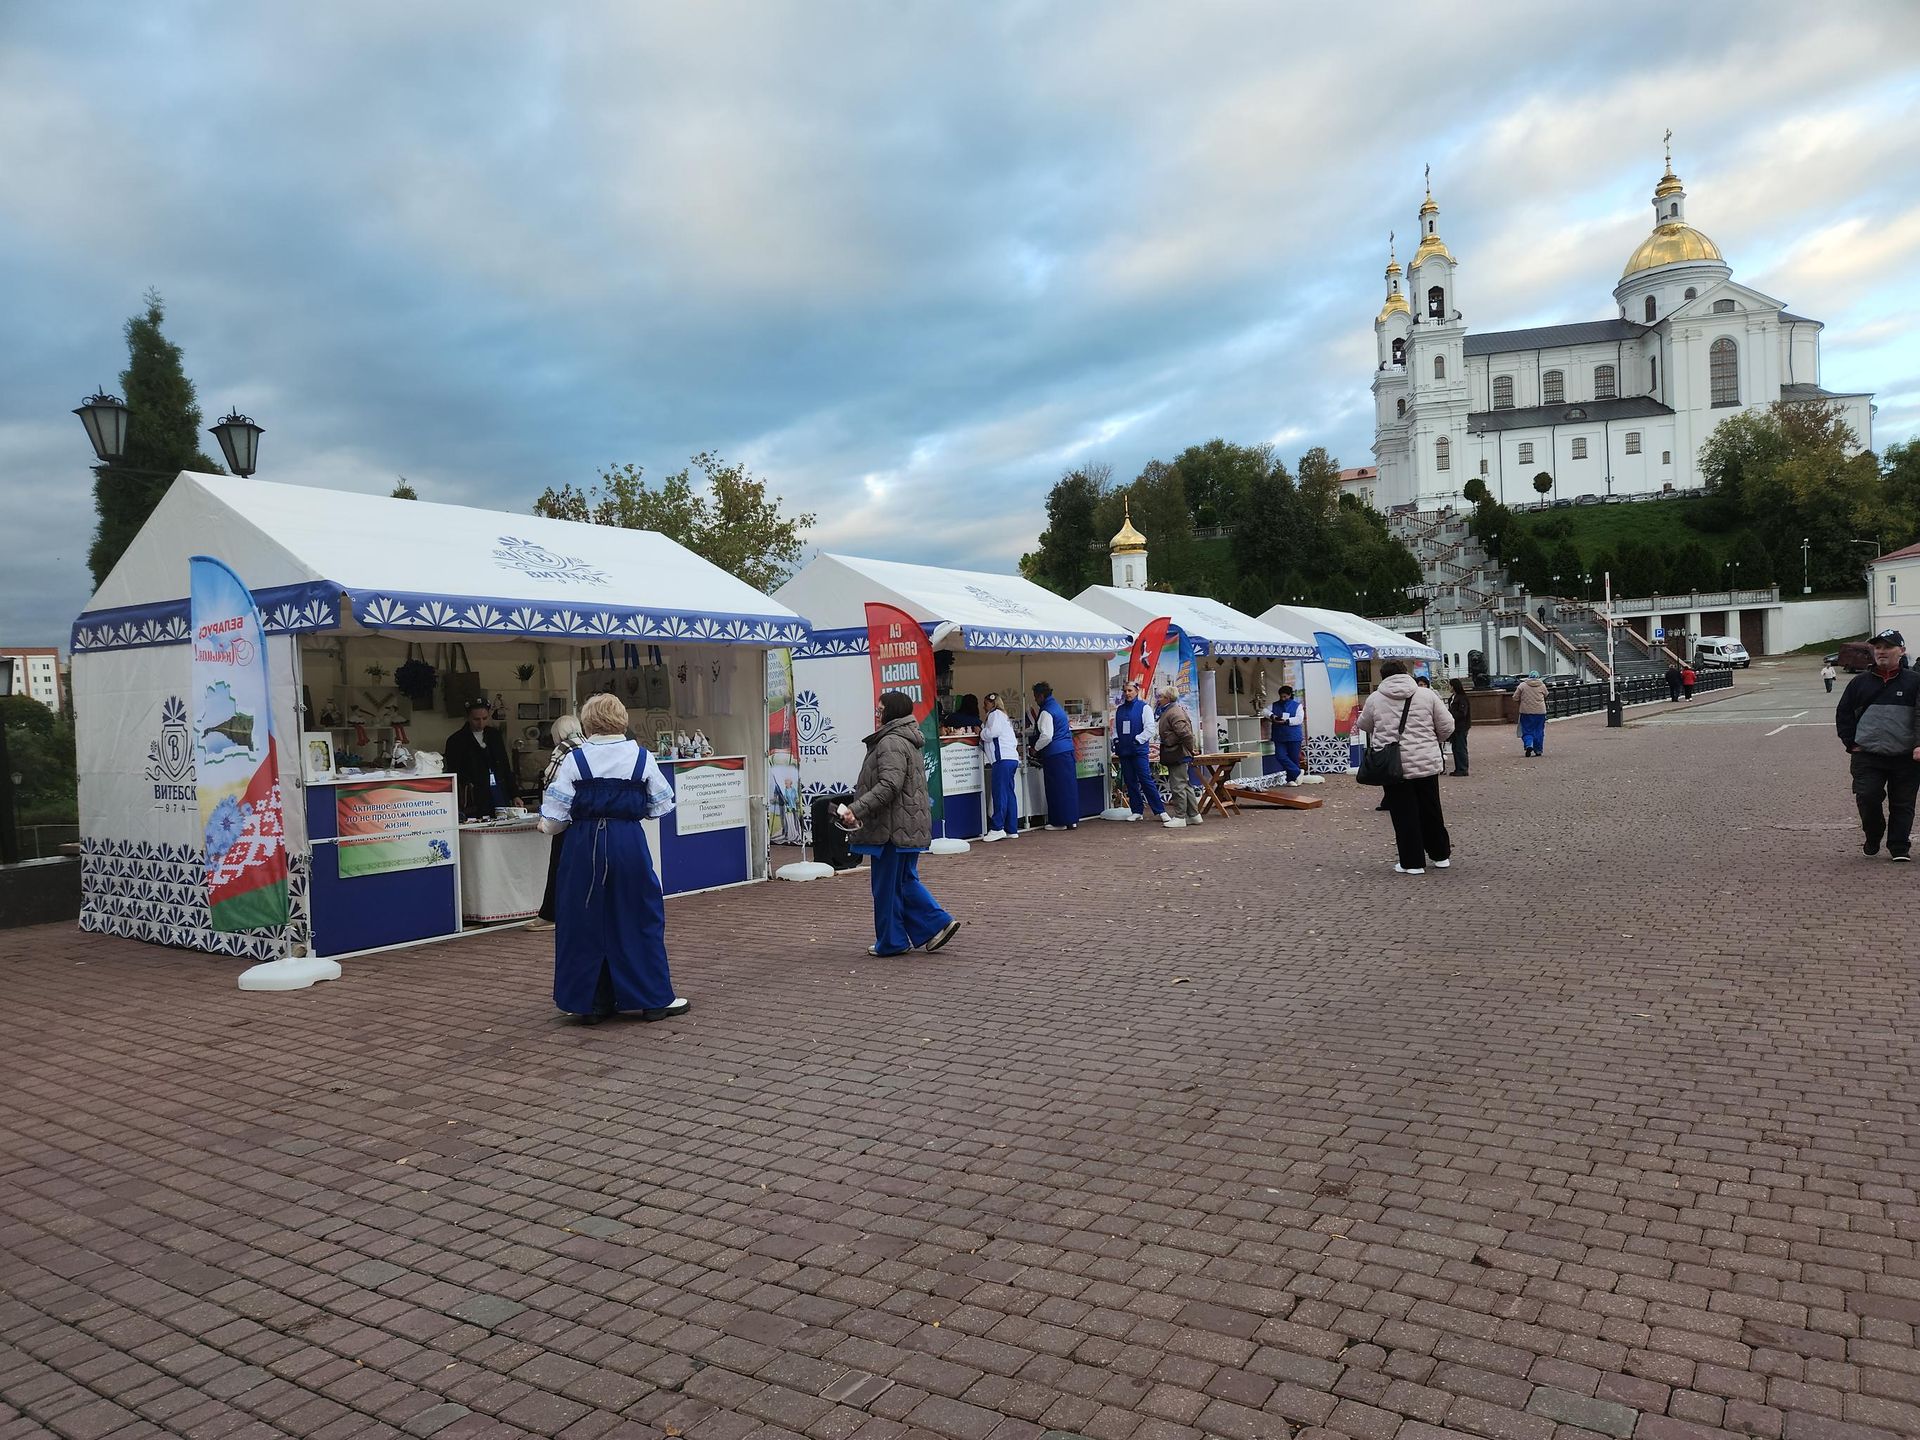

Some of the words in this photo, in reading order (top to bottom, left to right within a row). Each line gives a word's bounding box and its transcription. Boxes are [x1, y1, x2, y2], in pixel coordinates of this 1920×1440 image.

[525, 570, 608, 584] ВИТЕБСК
[799, 745, 828, 756] ТЕБСК
[154, 784, 197, 801] ВИТЕБСК
[165, 803, 186, 813] 974
[352, 803, 391, 813] Активное
[392, 800, 434, 810] долголетие
[371, 809, 448, 823] продолжительность
[384, 821, 412, 830] жизни,
